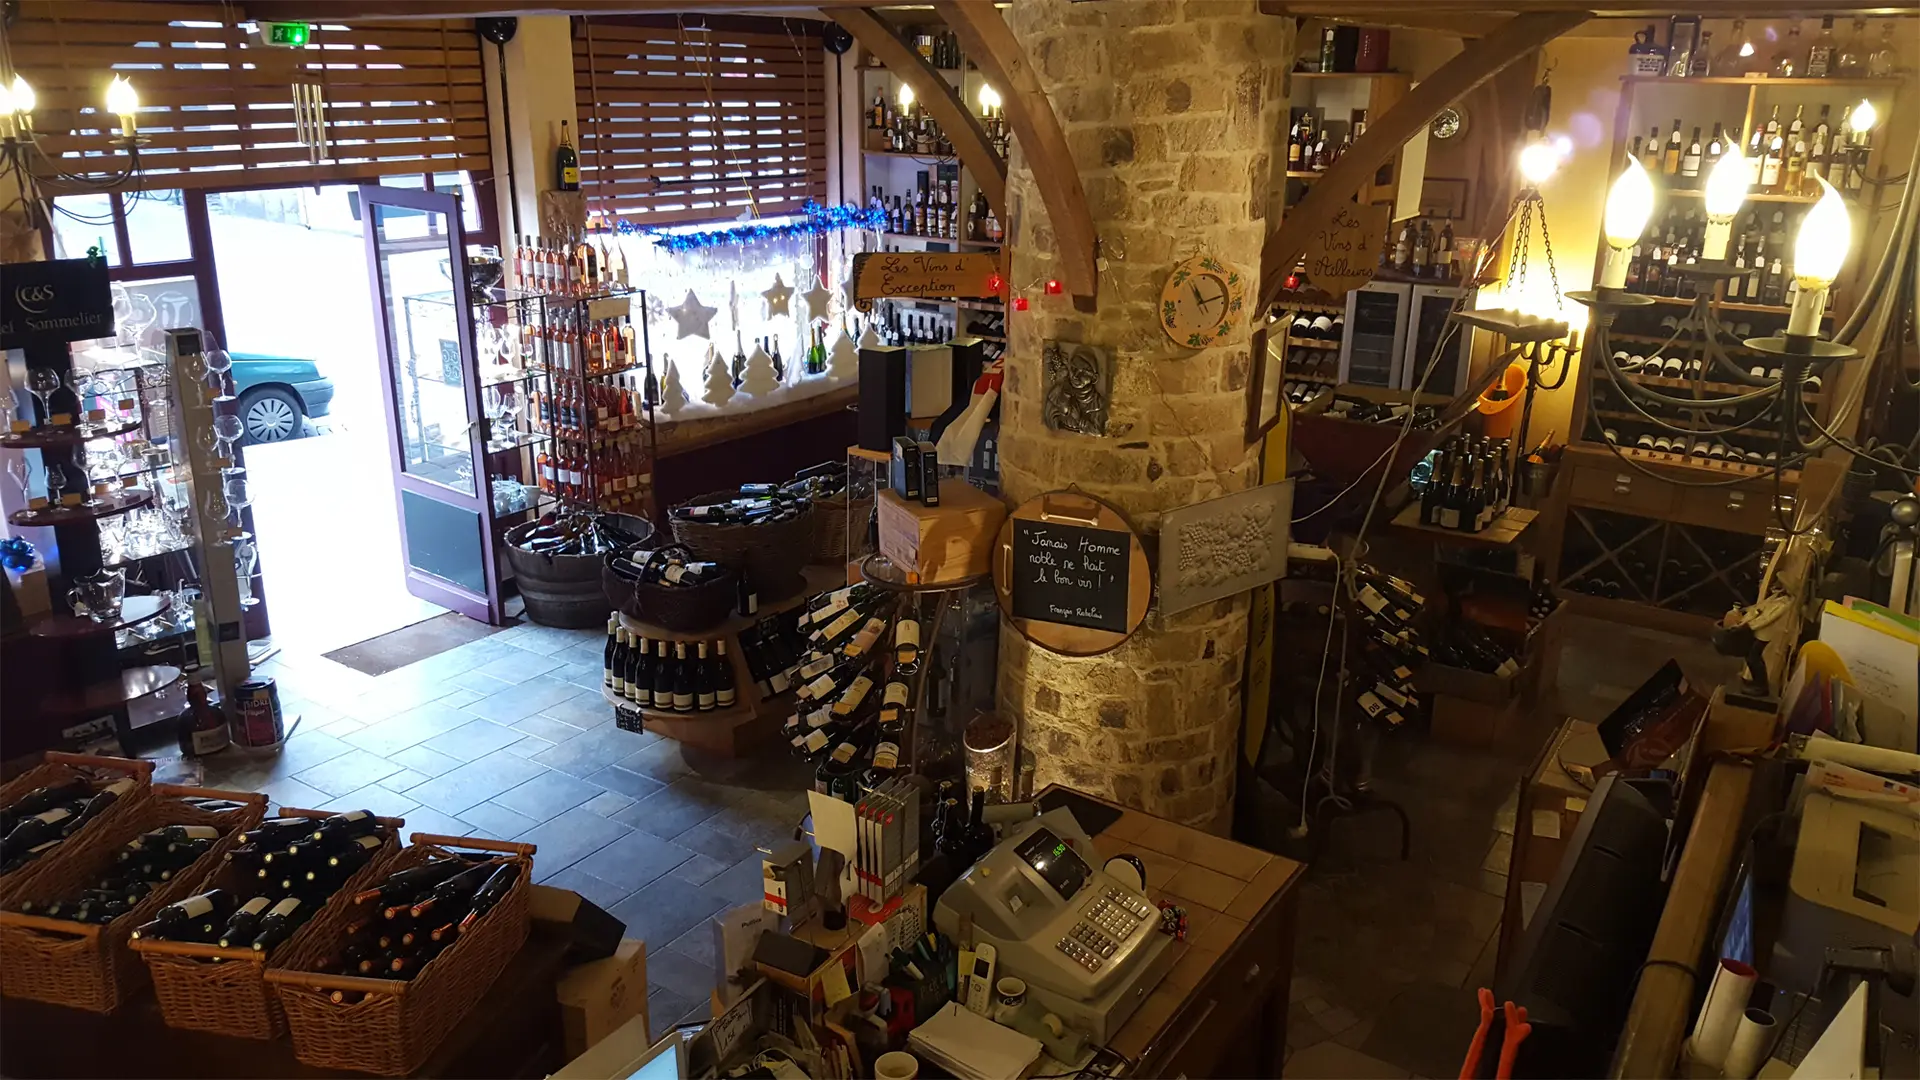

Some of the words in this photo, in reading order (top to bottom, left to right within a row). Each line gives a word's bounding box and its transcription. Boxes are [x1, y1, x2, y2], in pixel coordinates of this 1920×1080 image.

[1332, 210, 1359, 228] Les
[1319, 230, 1352, 251] Vins
[881, 256, 909, 273] Les
[913, 256, 948, 273] Vins
[1314, 256, 1373, 278] Ailleurs
[18, 284, 55, 304] C&S
[881, 273, 956, 297] Exception
[25, 312, 103, 332] Sommelier
[1078, 536, 1120, 555] Homme
[1029, 551, 1057, 566] noble
[1063, 560, 1075, 570] ne
[1083, 555, 1106, 572] hait
[1034, 568, 1048, 583] le
[1054, 569, 1073, 586] bon
